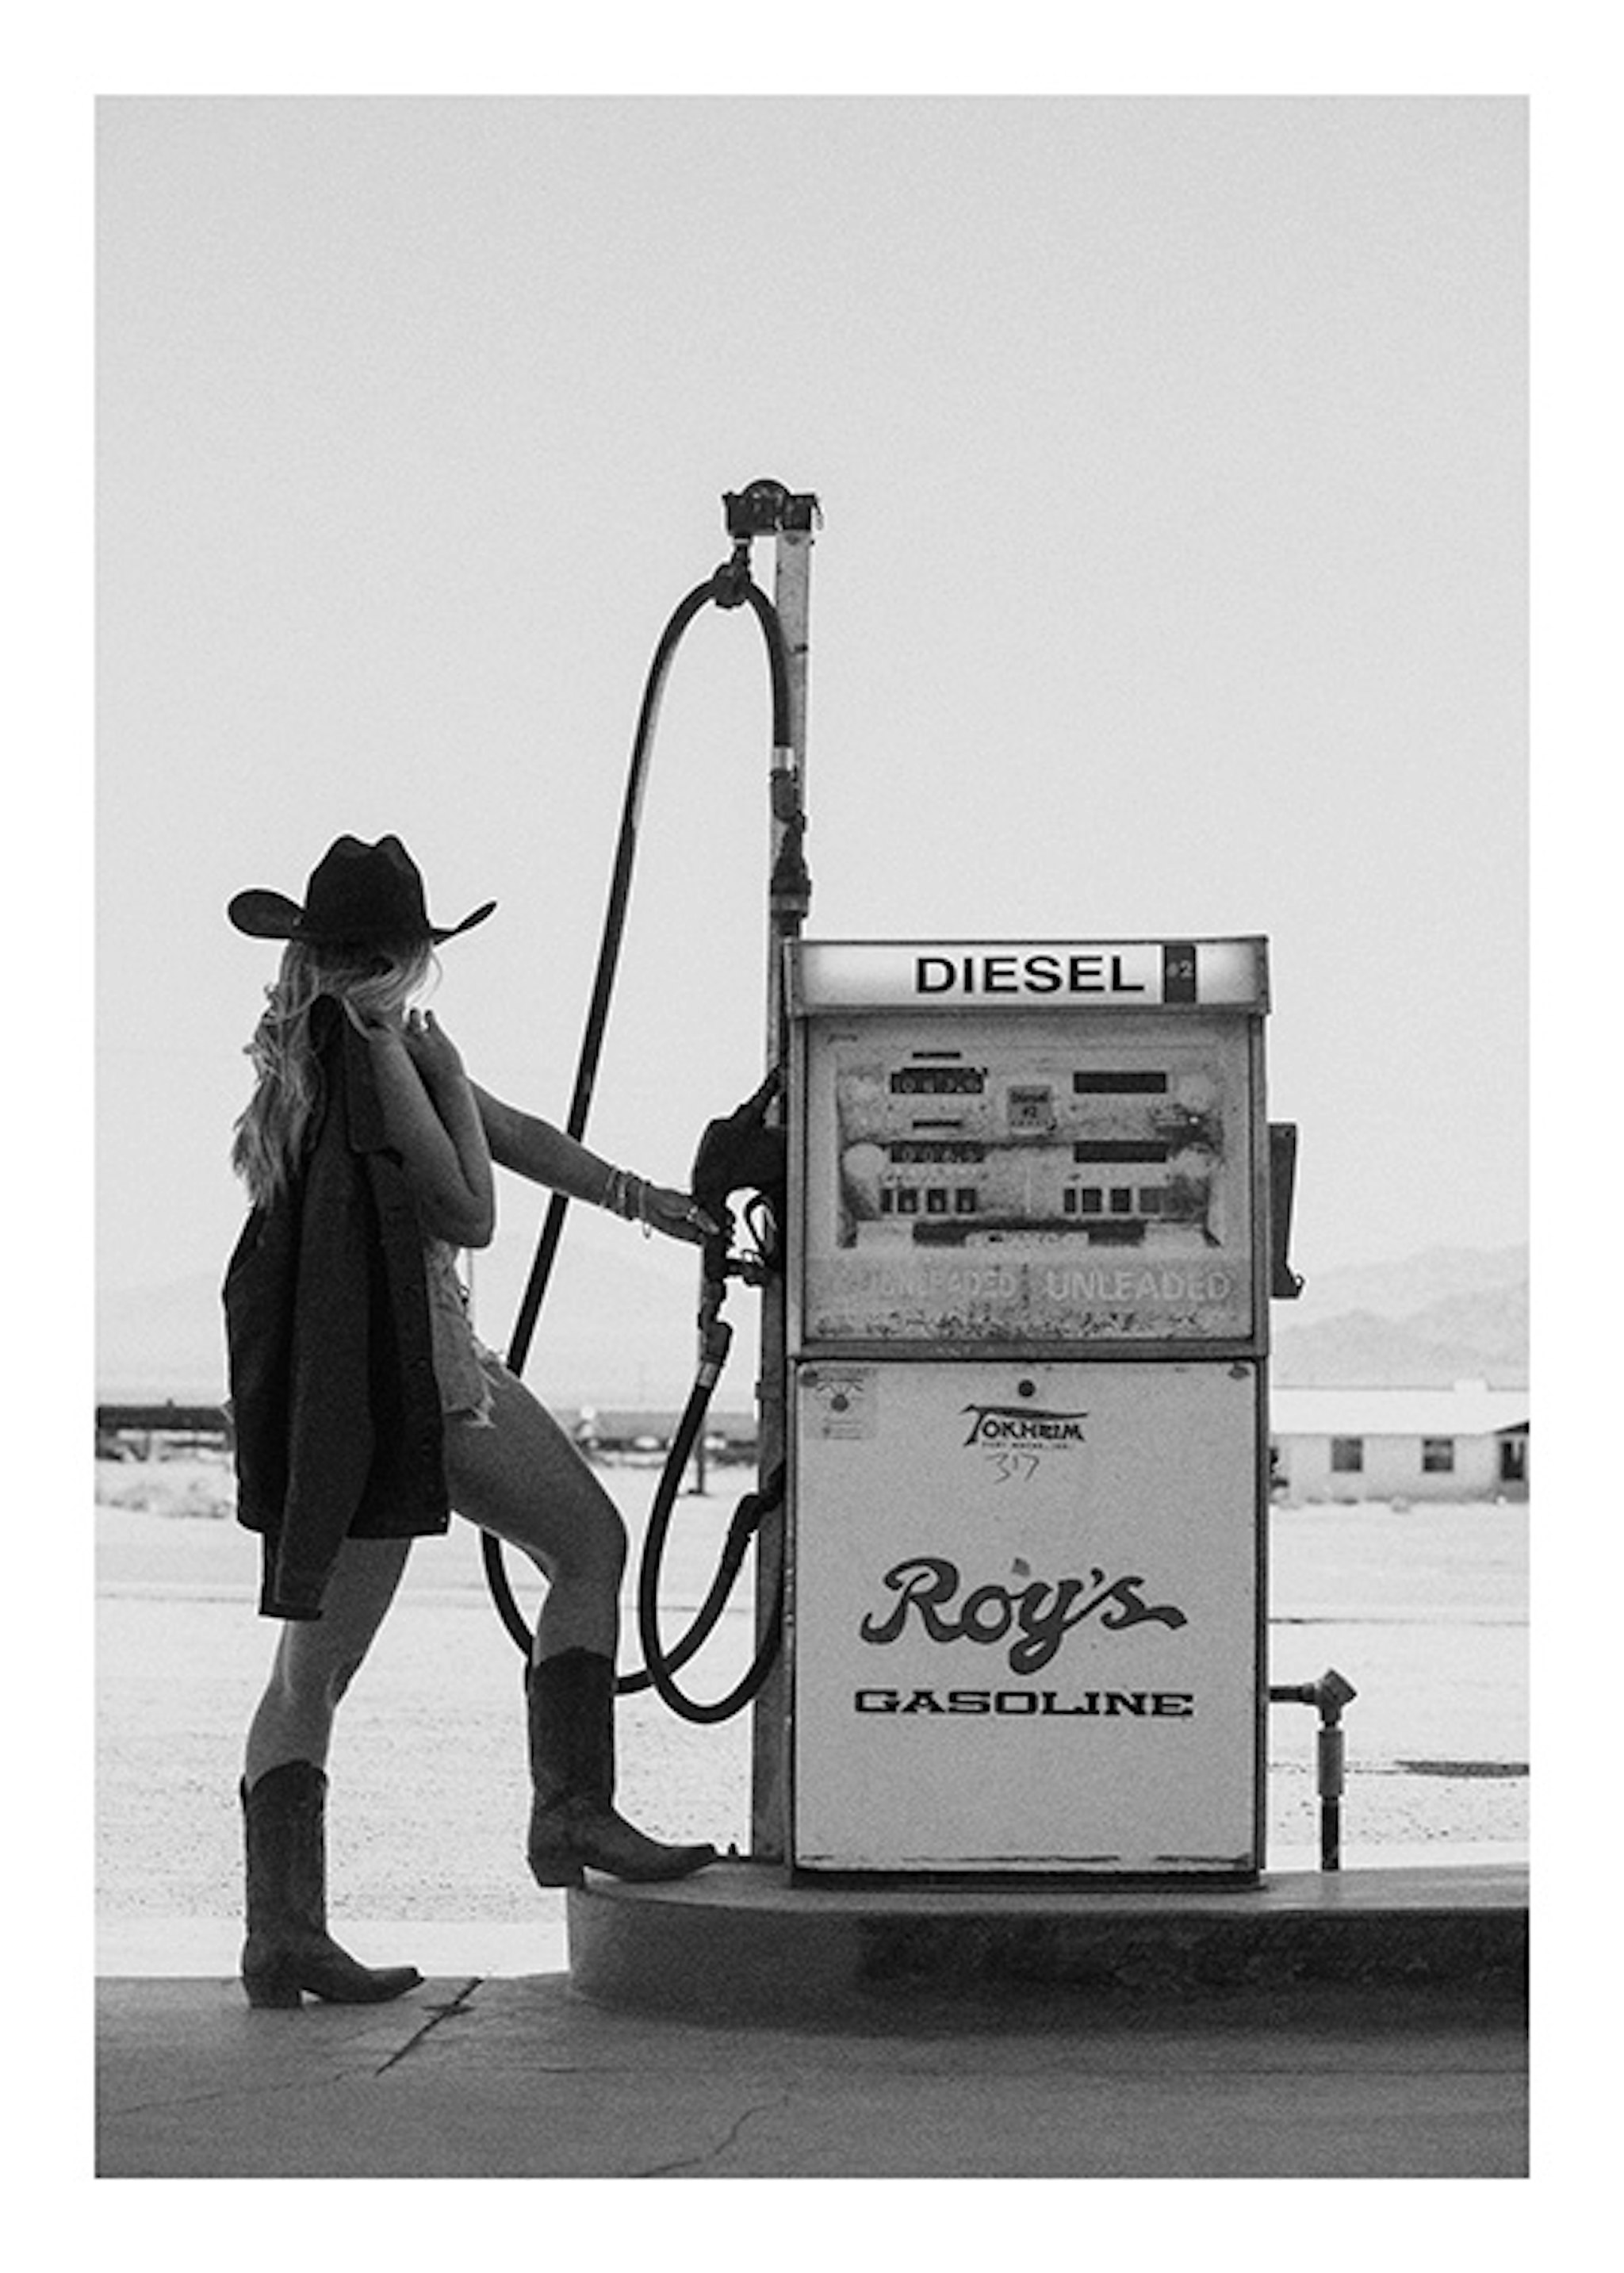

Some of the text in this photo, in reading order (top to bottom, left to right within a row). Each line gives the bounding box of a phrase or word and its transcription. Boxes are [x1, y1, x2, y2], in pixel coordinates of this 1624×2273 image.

[916, 955, 1145, 994] DIESEL
[1045, 1269, 1231, 1301] UNLEADED
[957, 1403, 1089, 1448] TOKHEIM
[860, 1557, 1188, 1676] Roy's
[854, 1689, 1193, 1718] GASOLINE
